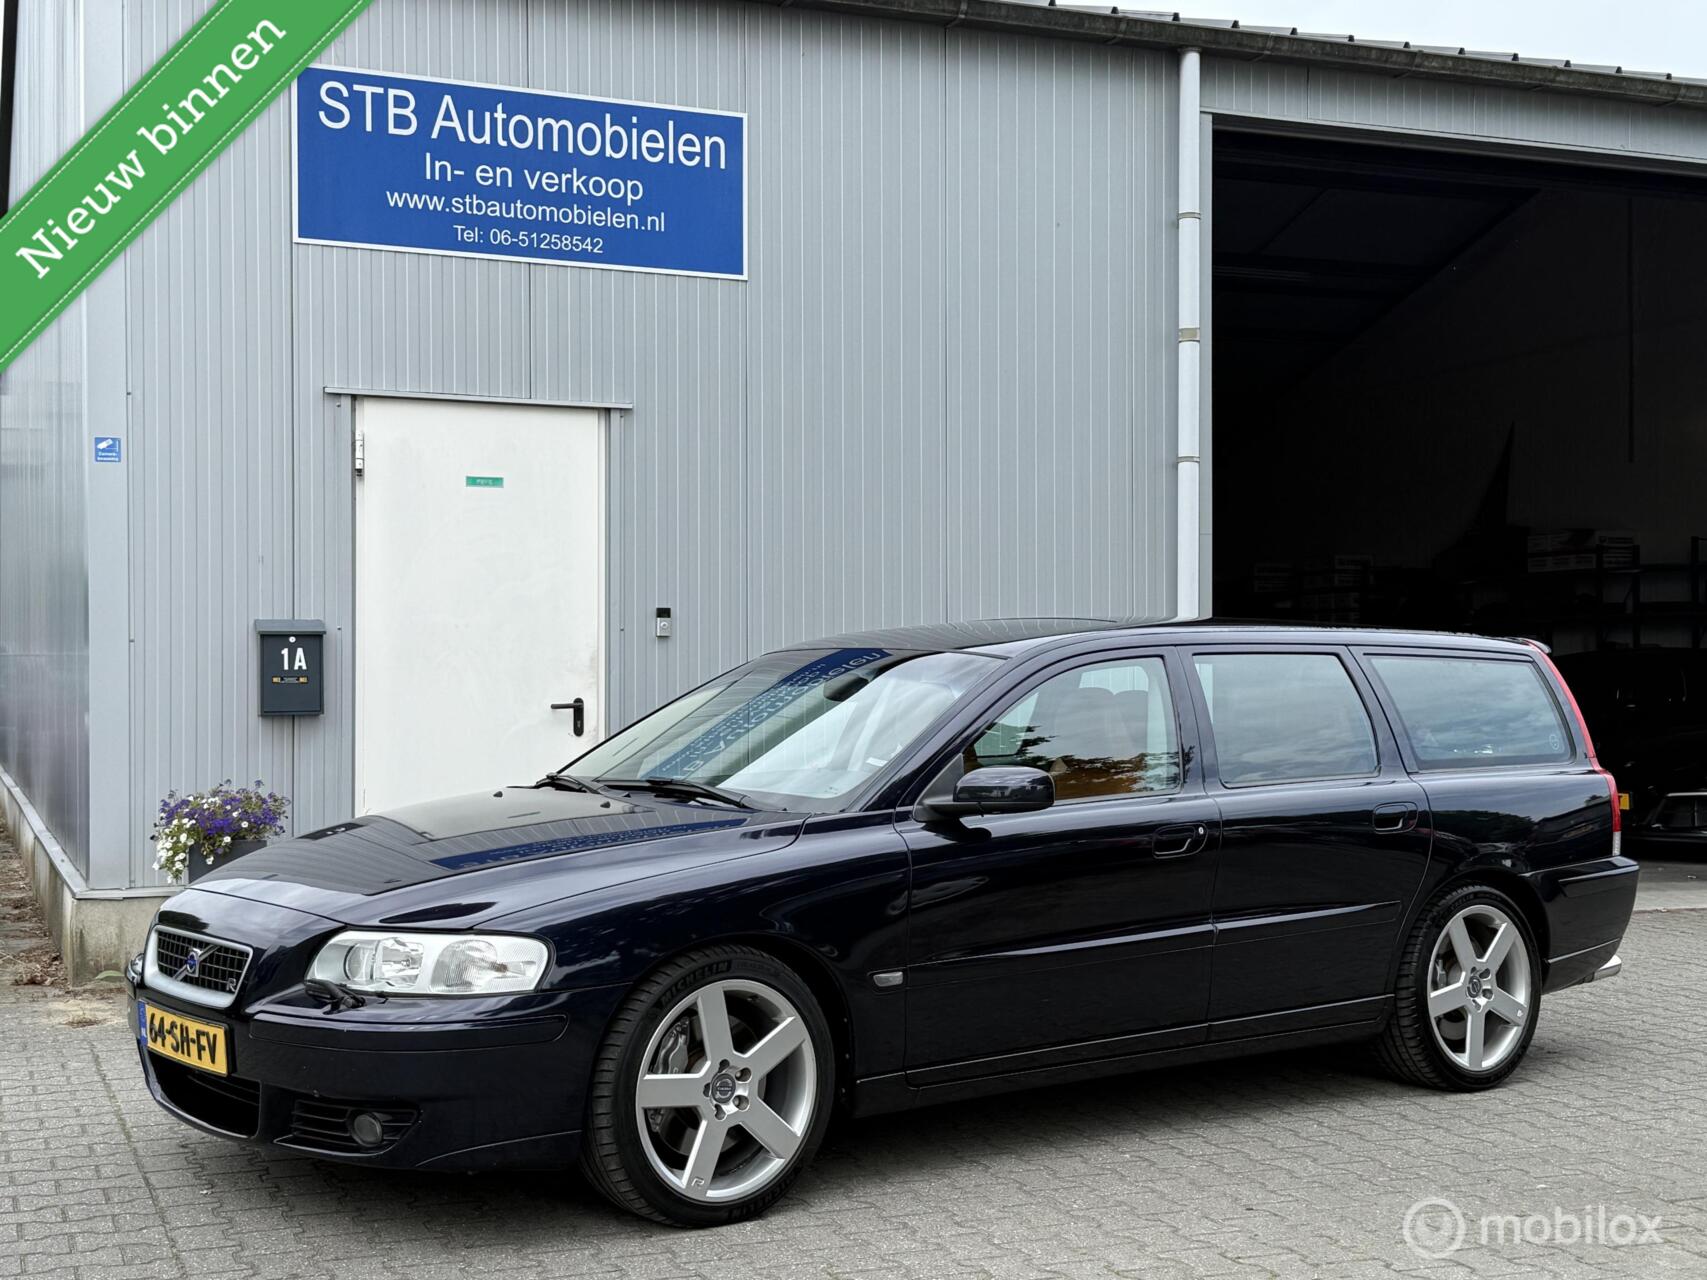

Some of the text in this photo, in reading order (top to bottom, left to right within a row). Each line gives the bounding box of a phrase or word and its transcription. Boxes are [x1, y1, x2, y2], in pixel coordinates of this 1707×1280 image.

[317, 80, 727, 169] STB Automobielen
[424, 153, 644, 205] In- en verkoop
[386, 190, 666, 231] www.stbautomobielen.nl
[453, 225, 604, 254] Tel: 06-51258542
[281, 647, 307, 670] 1A
[149, 1013, 216, 1064] 64-SH-FV
